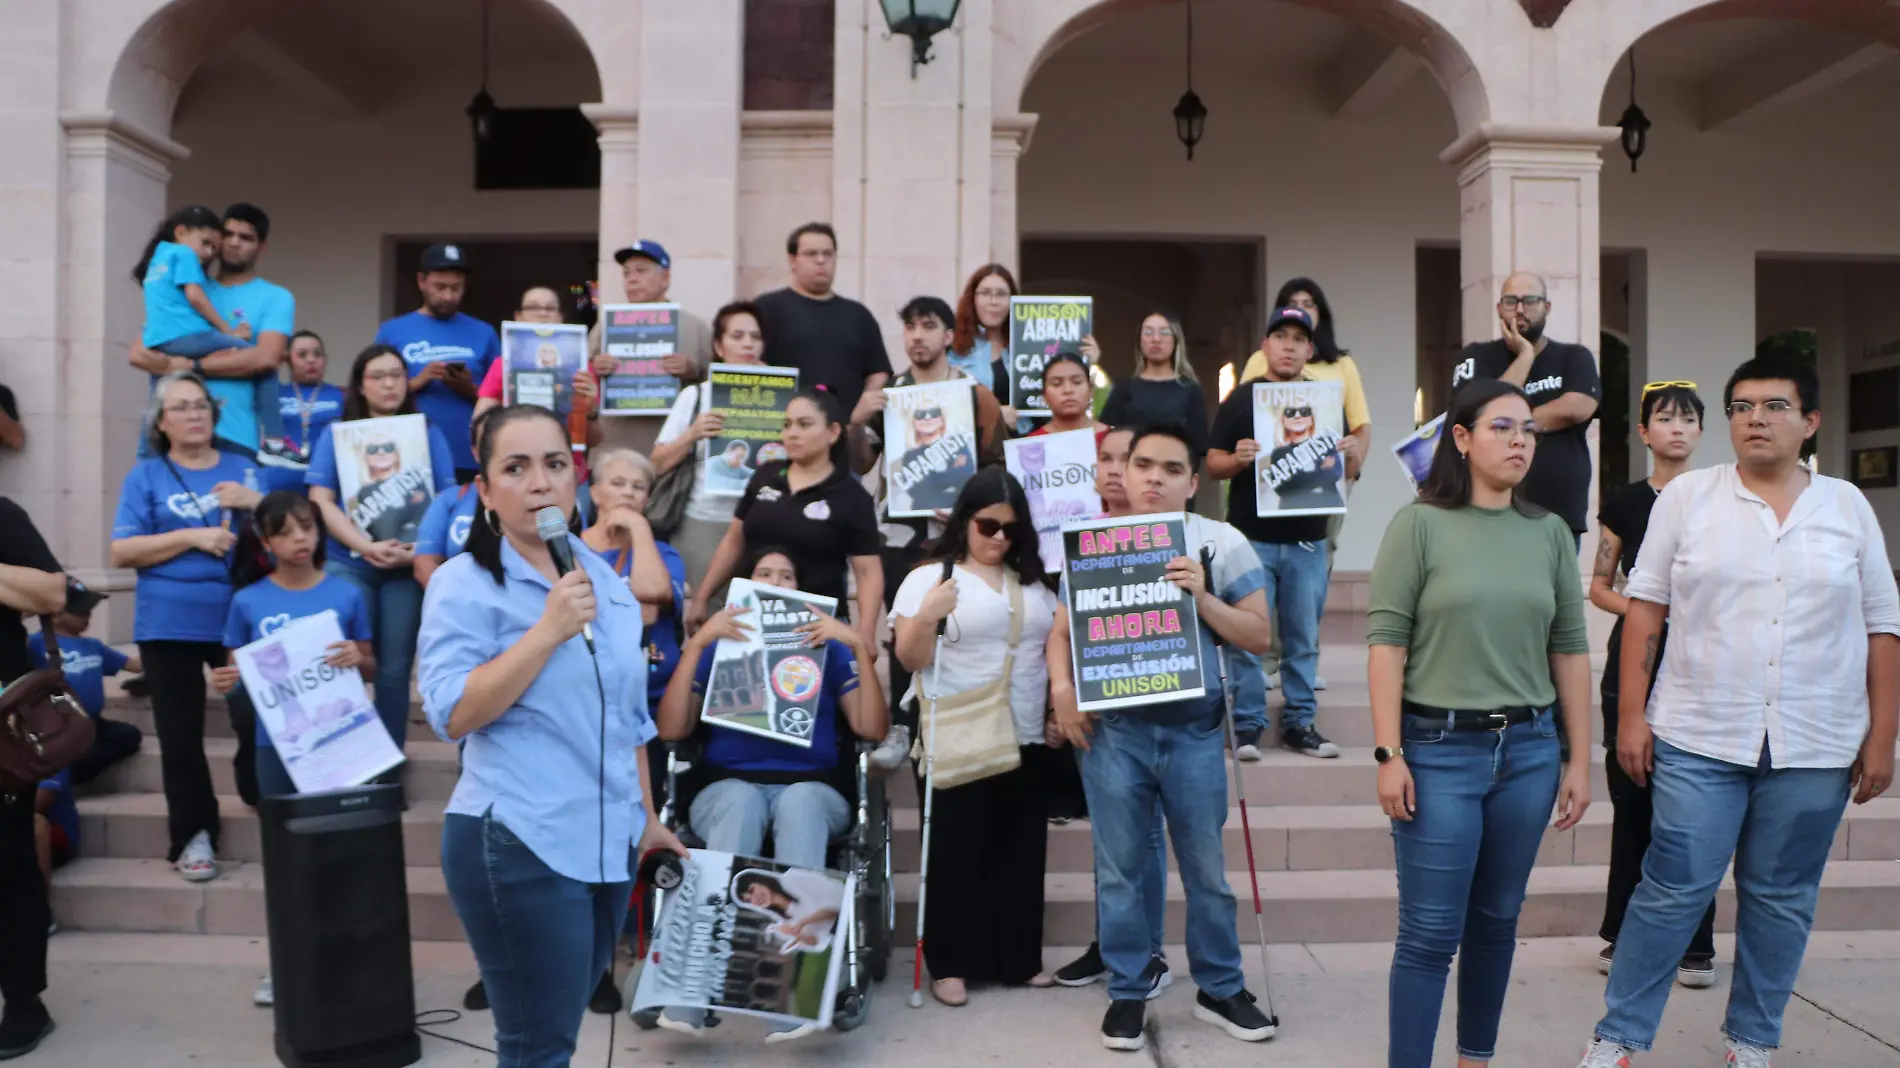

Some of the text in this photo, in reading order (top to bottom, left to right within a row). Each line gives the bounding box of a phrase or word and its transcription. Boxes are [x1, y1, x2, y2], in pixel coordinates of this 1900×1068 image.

[1014, 303, 1088, 322] UNISON
[1022, 318, 1080, 342] ABRAN
[711, 373, 794, 389] NECESITAMOS
[730, 386, 776, 406] MÁS
[1079, 523, 1172, 555] ANTES
[1071, 550, 1179, 572] DEPARTAMENTO
[1076, 576, 1182, 612] INCLUSIÓN
[761, 599, 787, 612] YA
[1088, 609, 1181, 641] AHORA
[1083, 637, 1187, 659] DEPARTAMENTO
[1081, 653, 1197, 682] EXCLUSIÓN
[1102, 673, 1181, 697] UNISON
[697, 903, 716, 917] A
